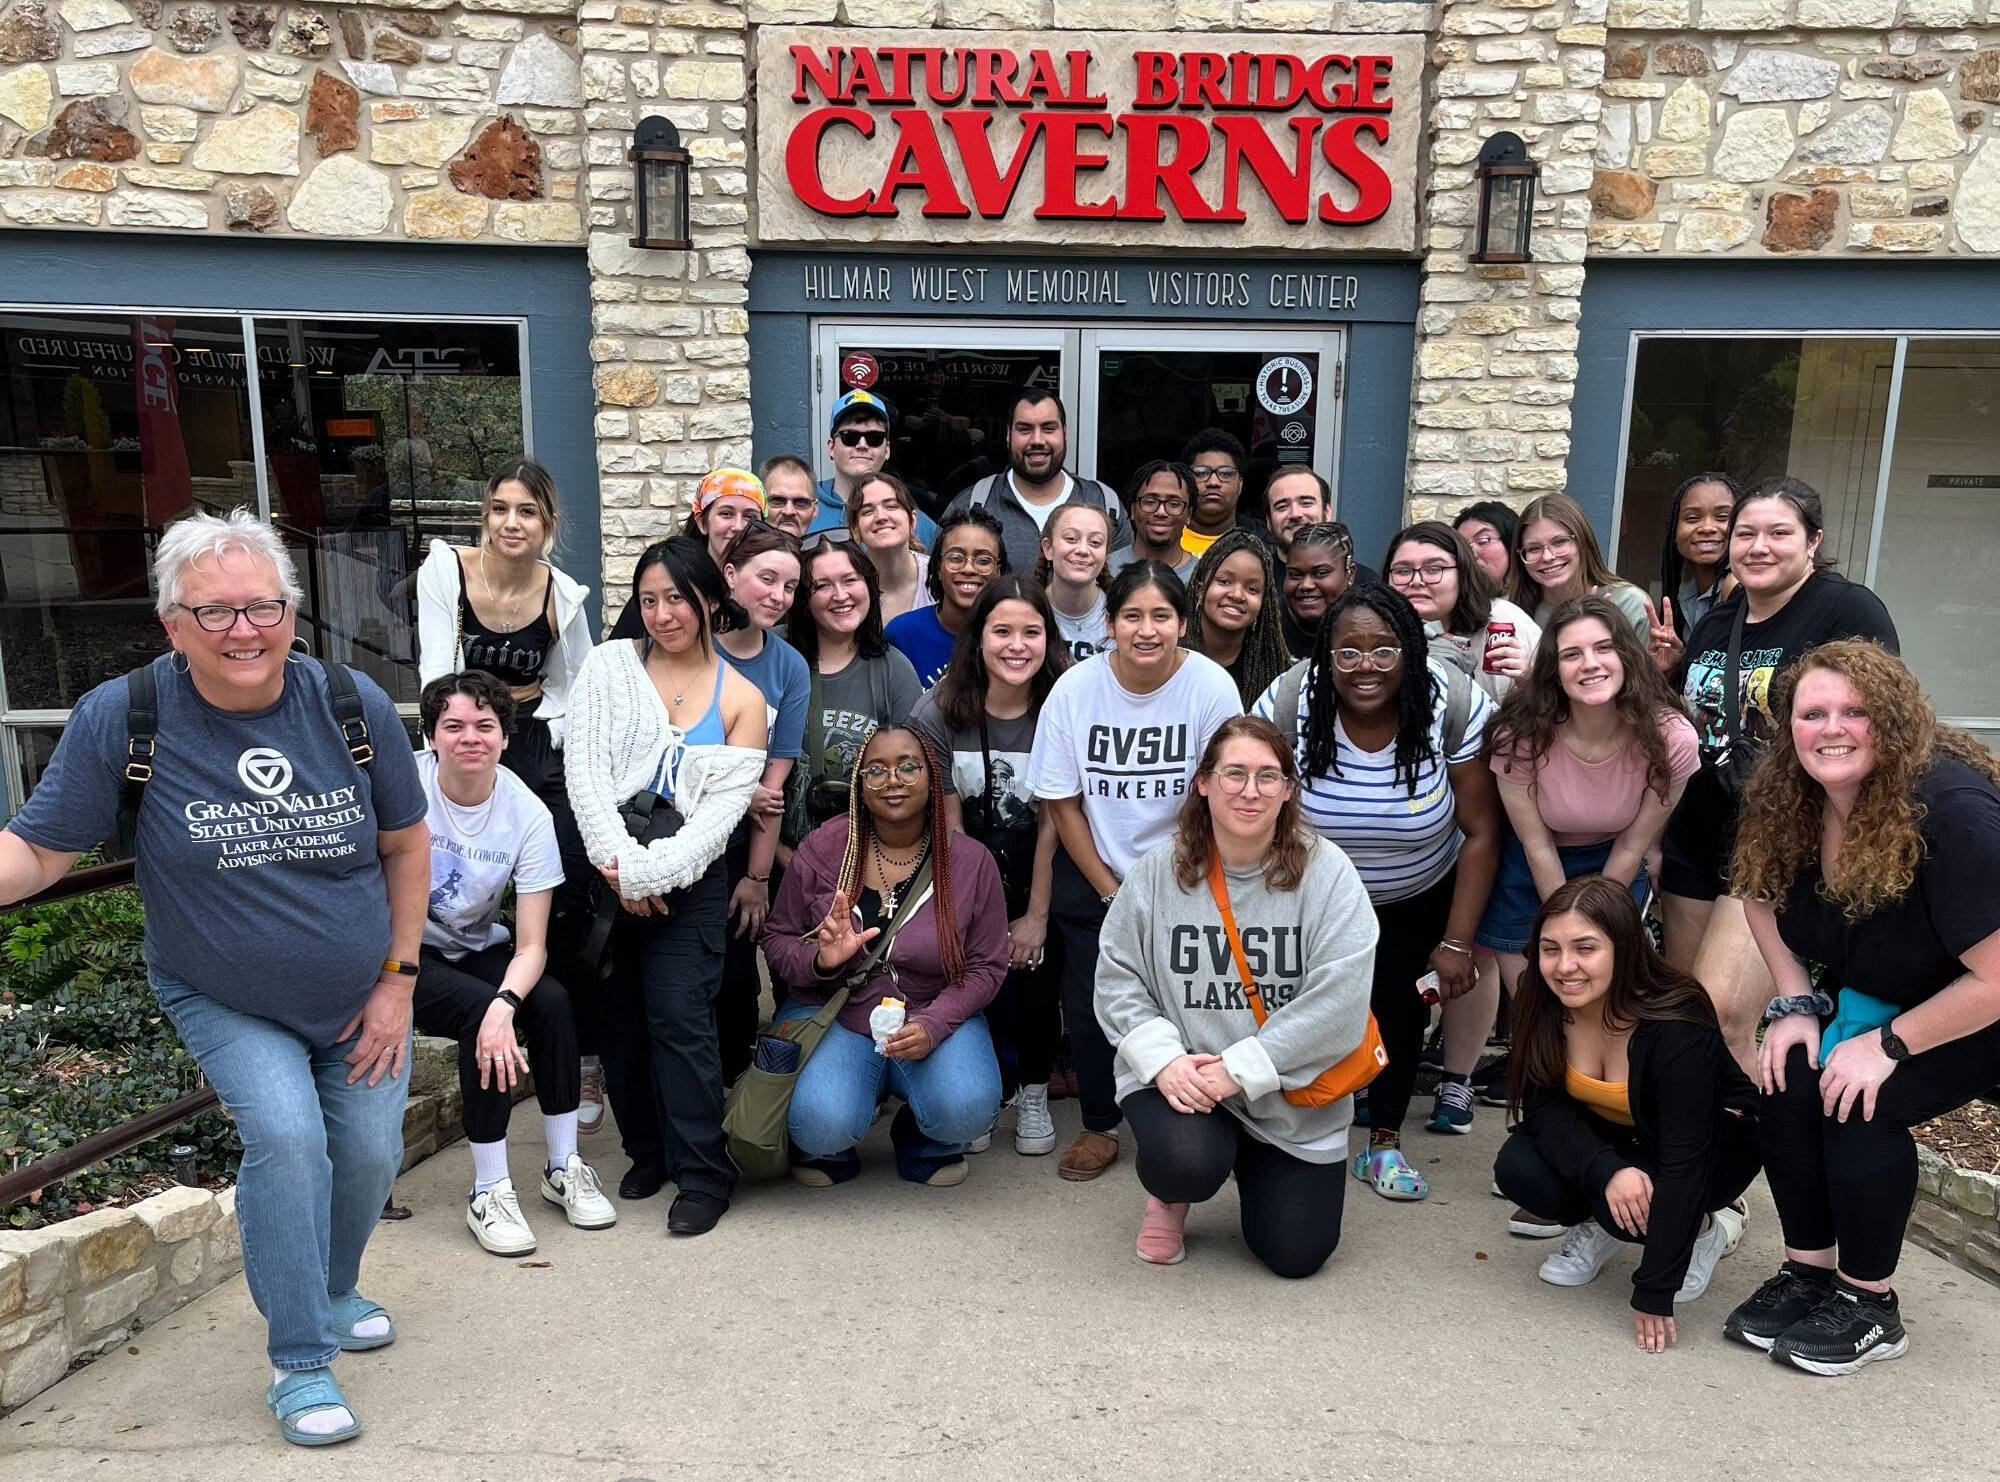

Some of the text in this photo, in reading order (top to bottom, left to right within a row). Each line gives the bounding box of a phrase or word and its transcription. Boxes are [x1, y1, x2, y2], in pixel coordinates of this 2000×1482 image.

[789, 45, 1394, 113] NATURAL BRIDGE
[786, 107, 1393, 226] CAVERNS
[804, 266, 1358, 309] HILMAR WUEST MEMORIAL VISITORS CENTER
[1258, 359, 1310, 387] HISTORIC BUSINESS
[1260, 391, 1309, 413] TEXAS TREASURE
[1949, 477, 1984, 486] PRIVATE
[461, 632, 541, 676] Juicy
[1087, 723, 1187, 765] GVSU
[185, 785, 356, 822] GRAND VALLEY
[1088, 778, 1186, 800] LAKERS
[188, 822, 249, 839] STATE
[221, 831, 347, 856] LAKER ACADEMIC
[216, 842, 357, 870] ADVISING NETWORK
[446, 838, 465, 857] RIDE
[474, 848, 512, 866] COWGIRL
[1170, 924, 1302, 978] GVSU
[1183, 980, 1294, 1012] LAKRS
